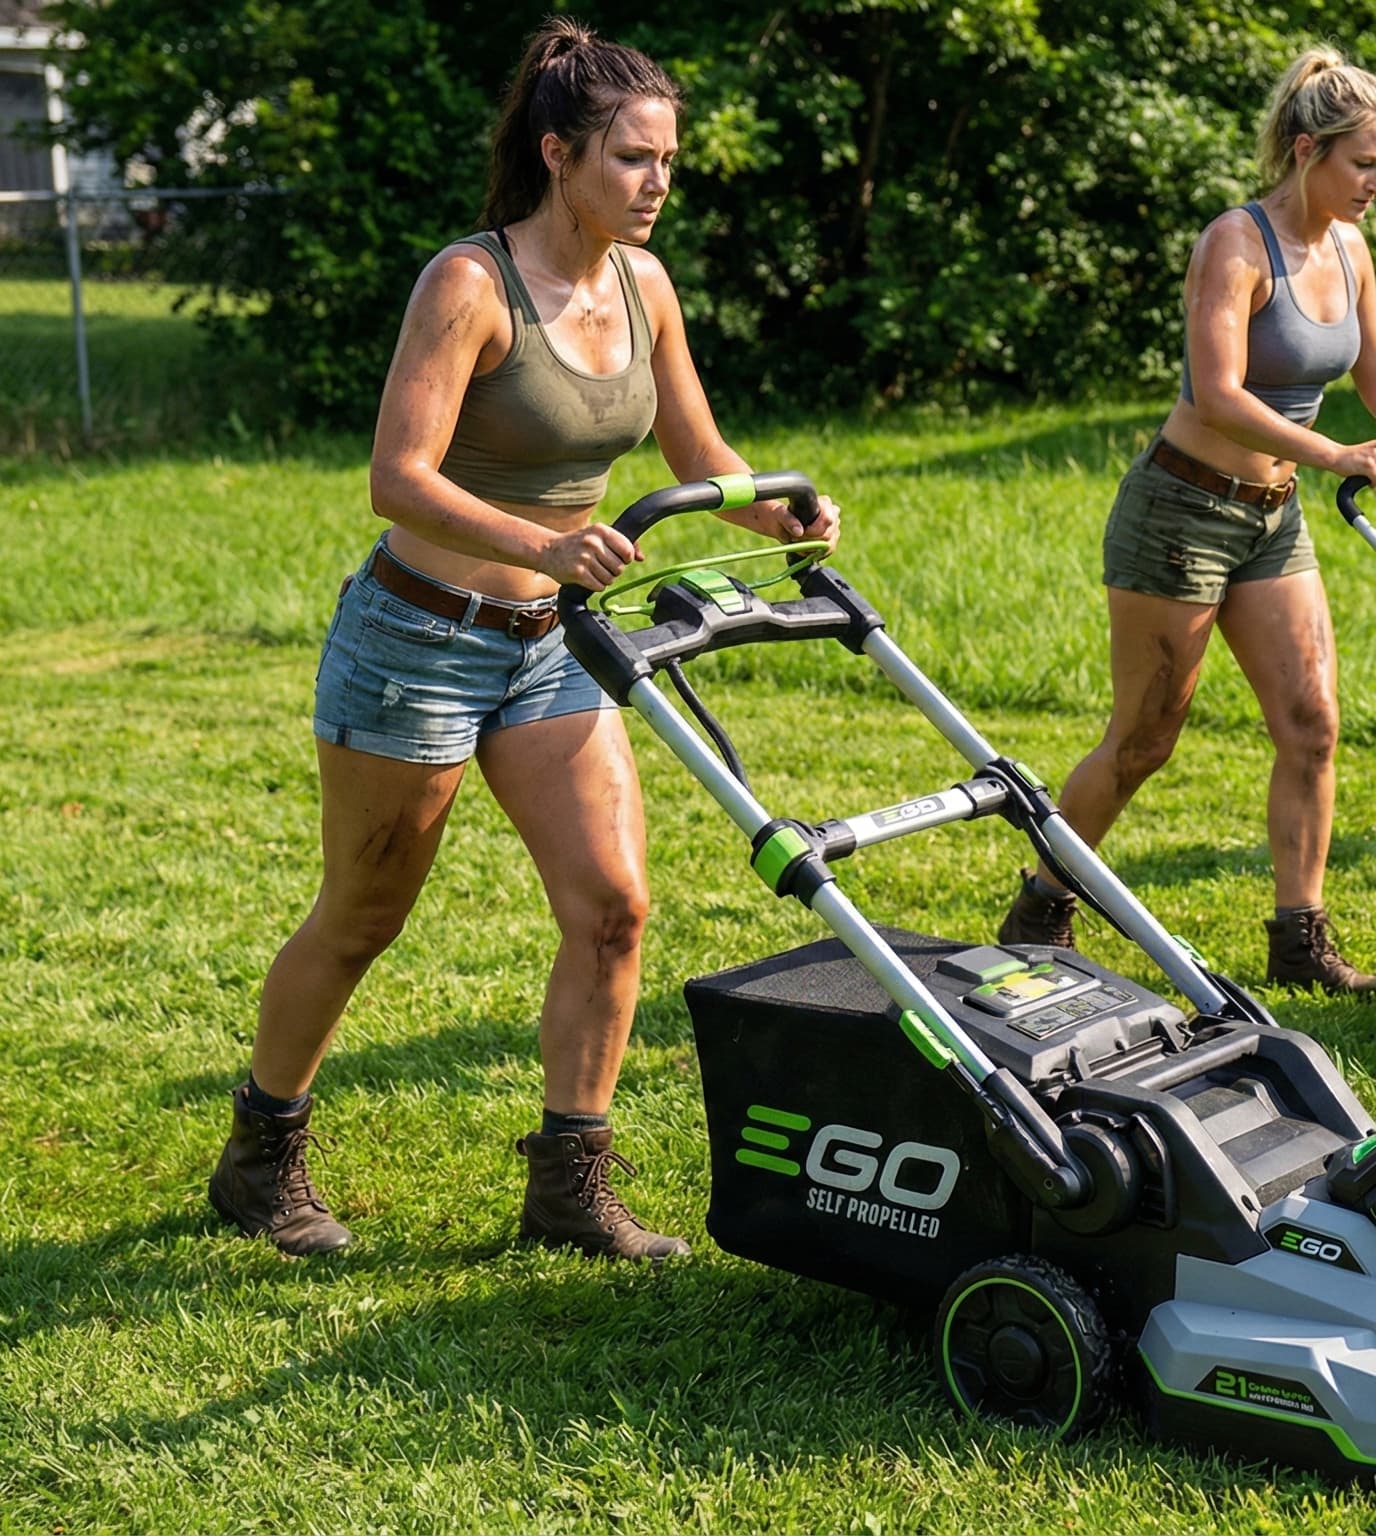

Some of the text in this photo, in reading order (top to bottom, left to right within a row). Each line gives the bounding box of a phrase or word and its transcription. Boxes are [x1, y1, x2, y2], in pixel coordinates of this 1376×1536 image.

[735, 1104, 961, 1210] EGO
[806, 1187, 940, 1238] SELF PROPELLED
[1280, 1231, 1343, 1261] EGO
[1215, 1371, 1248, 1398] 21
